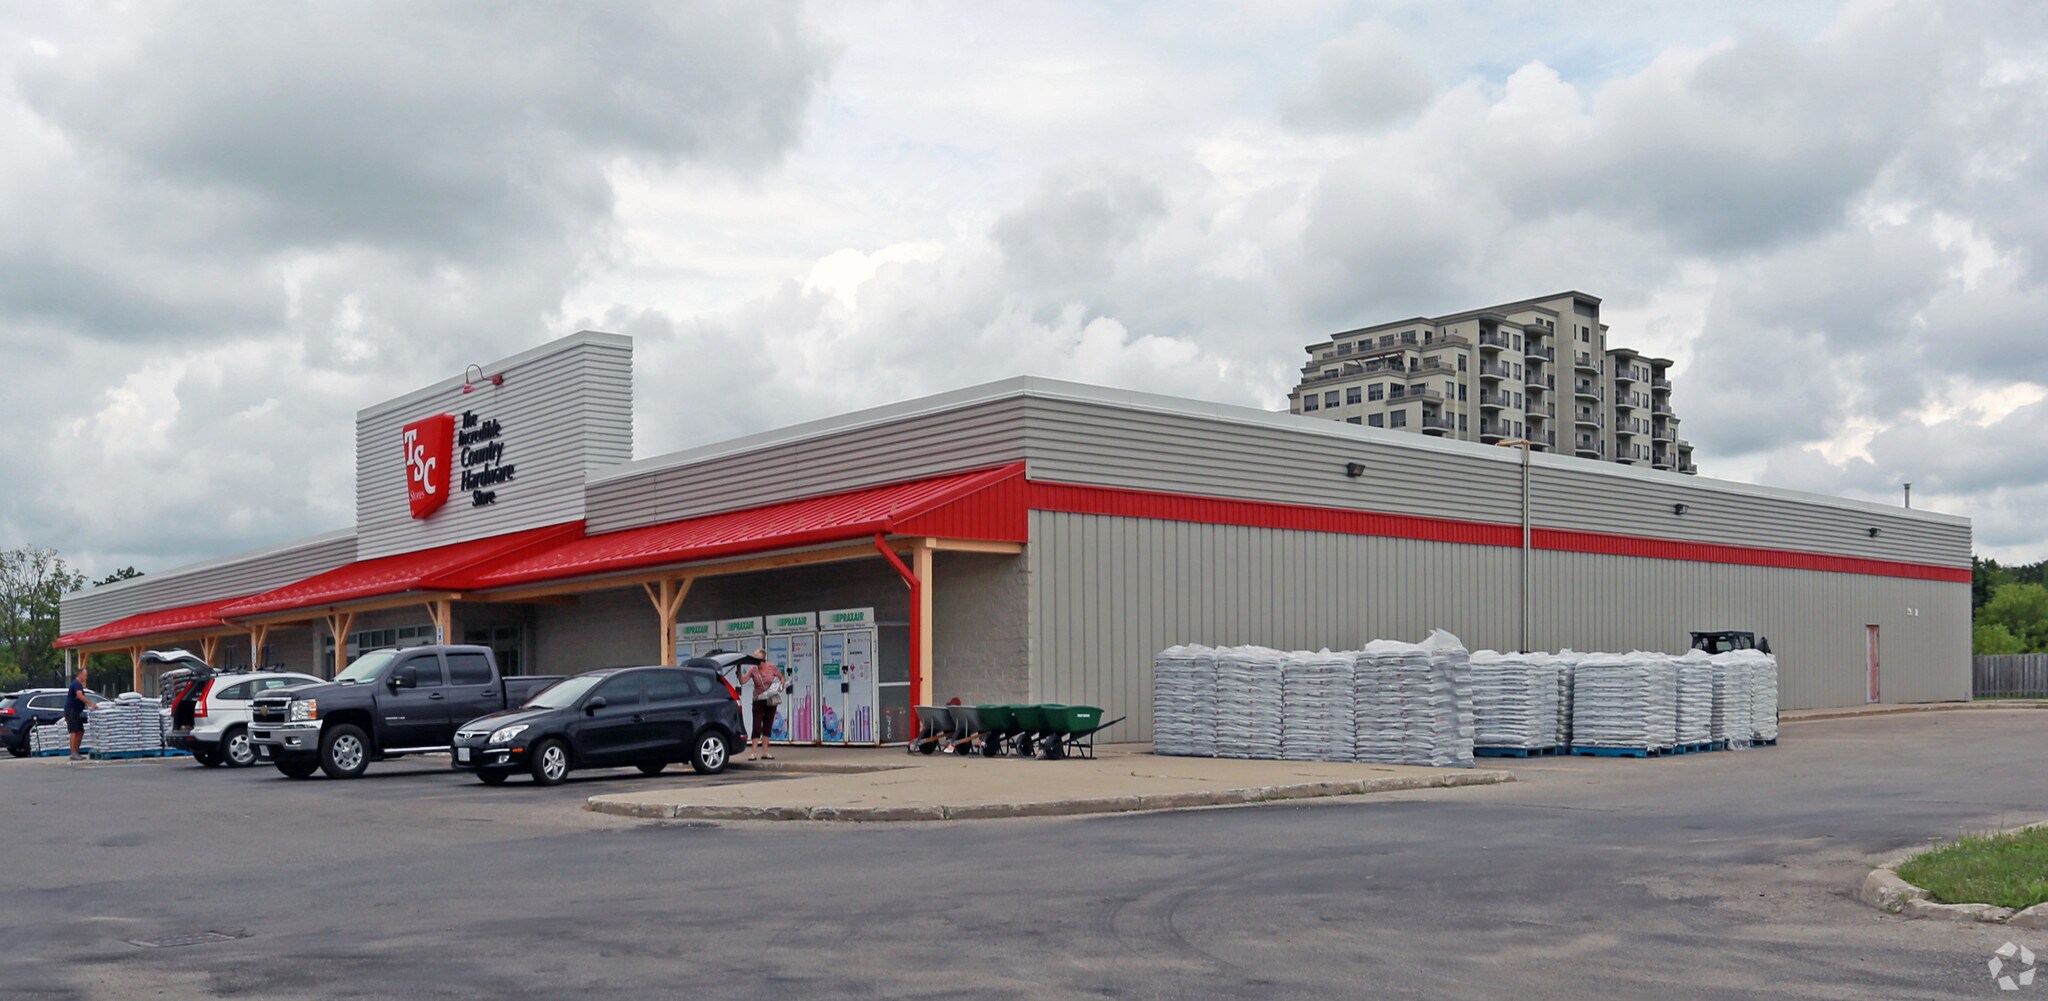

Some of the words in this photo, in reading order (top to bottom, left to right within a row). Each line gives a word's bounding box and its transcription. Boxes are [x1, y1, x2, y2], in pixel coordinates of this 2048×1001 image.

[461, 409, 478, 429] The
[405, 428, 436, 494] TSC
[461, 440, 504, 467] Country
[461, 463, 515, 491] Hardware
[472, 490, 496, 507] Store
[784, 616, 807, 626] PRAXAIR
[839, 611, 865, 622] PRAXAIR
